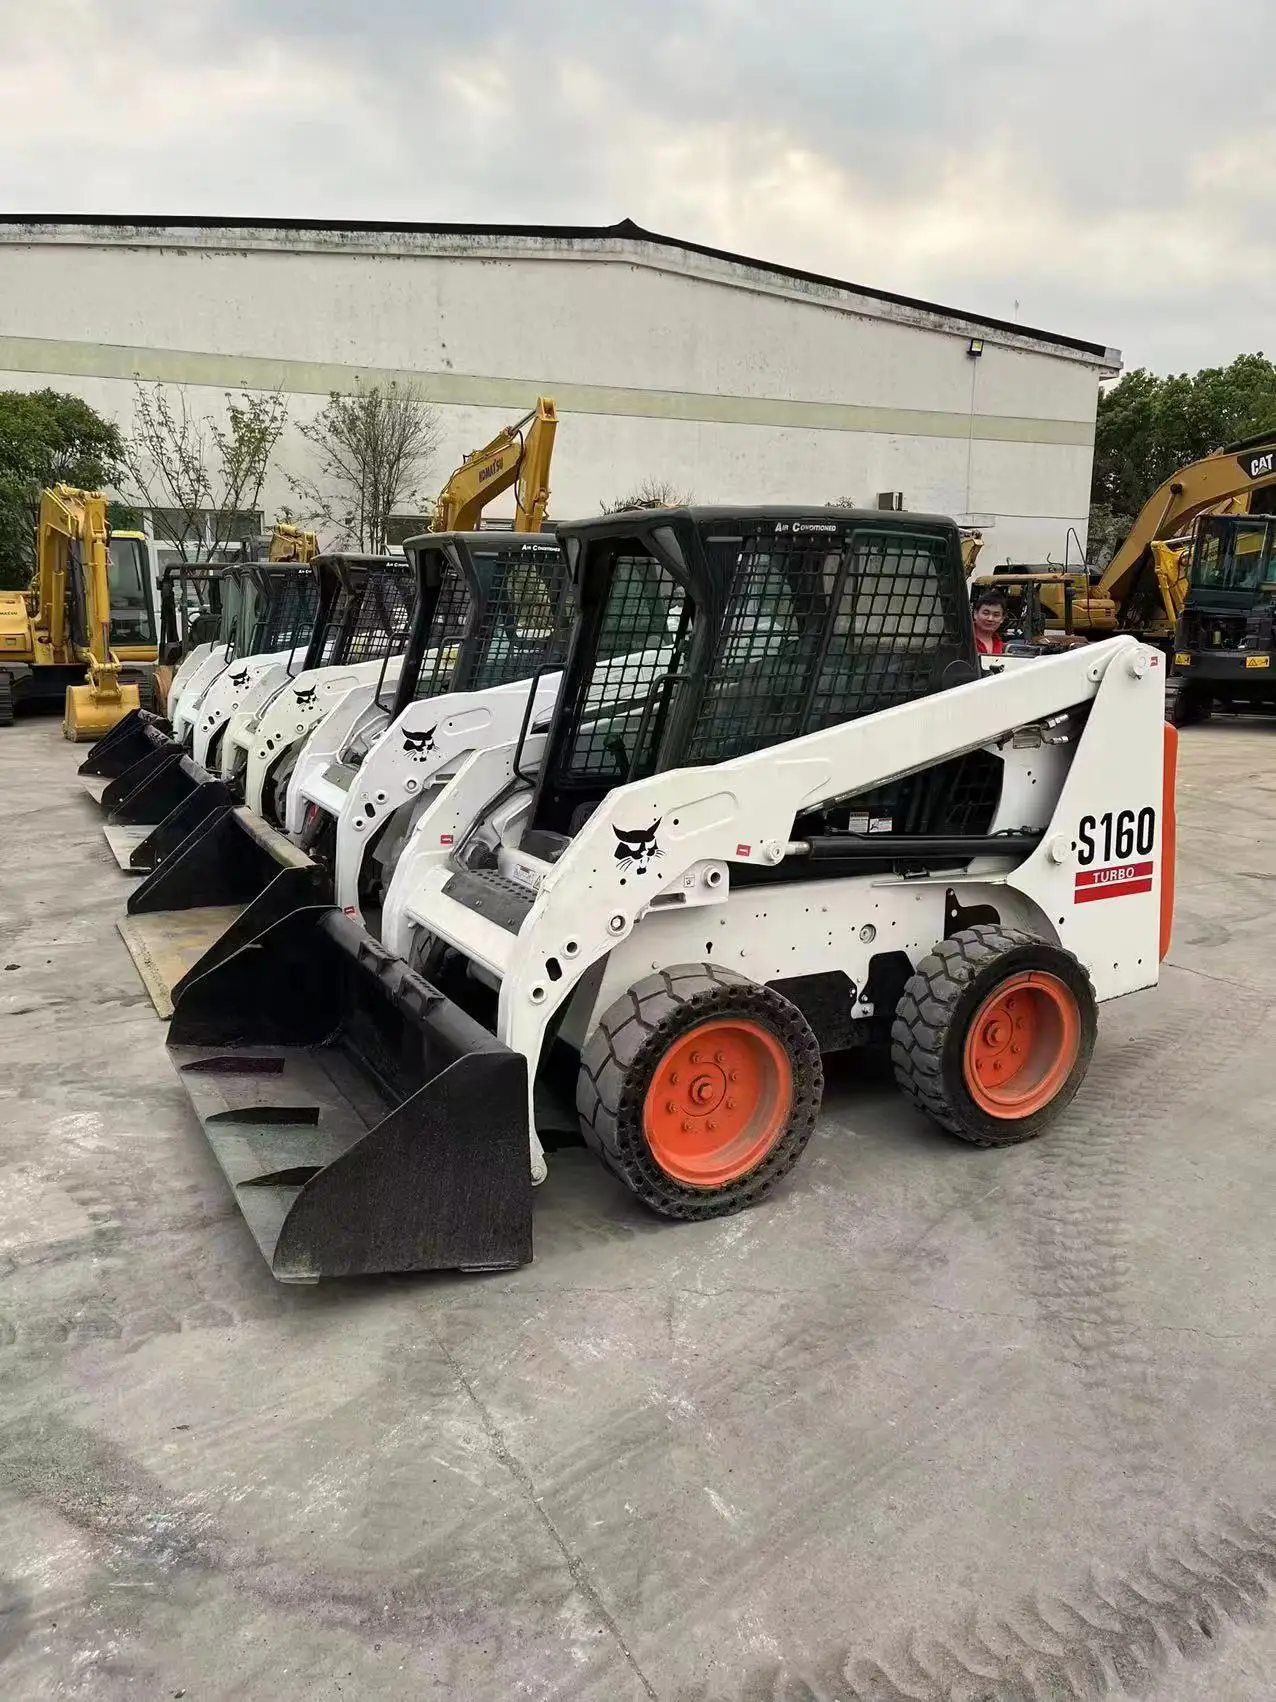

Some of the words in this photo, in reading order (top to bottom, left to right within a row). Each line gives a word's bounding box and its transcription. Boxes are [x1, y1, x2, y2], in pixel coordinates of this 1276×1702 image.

[479, 456, 504, 483] KOMATSU
[1251, 453, 1273, 476] CAT
[775, 522, 789, 532] AIR
[792, 522, 837, 533] CONDITIONED
[1078, 806, 1155, 865] S160
[1093, 867, 1135, 884] TURBO
